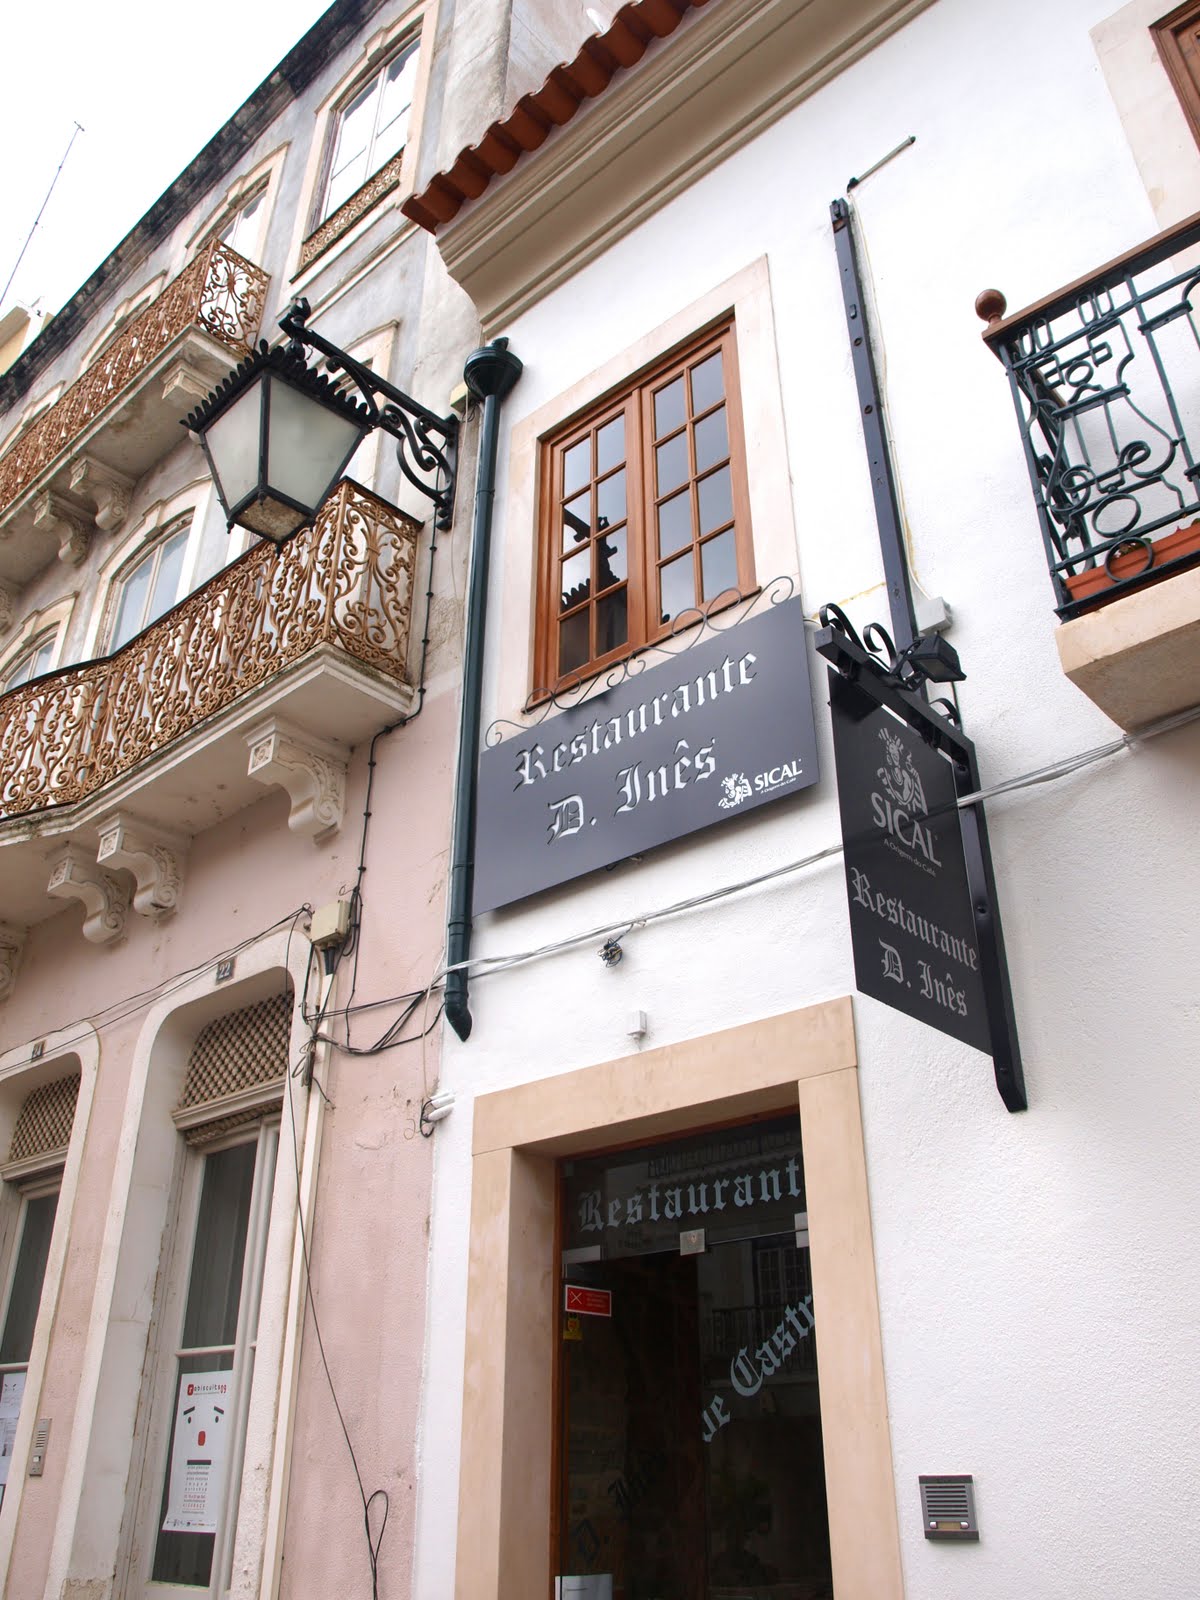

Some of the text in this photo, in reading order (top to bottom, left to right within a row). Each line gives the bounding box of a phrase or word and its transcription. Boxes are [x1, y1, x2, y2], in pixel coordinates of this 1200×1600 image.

[513, 652, 757, 792] Restaurante
[547, 738, 715, 844] D. Inês
[754, 760, 803, 791] SICAL
[871, 792, 942, 868] SICAL
[851, 866, 978, 971] Restaurante
[879, 937, 968, 1017] D. Inês
